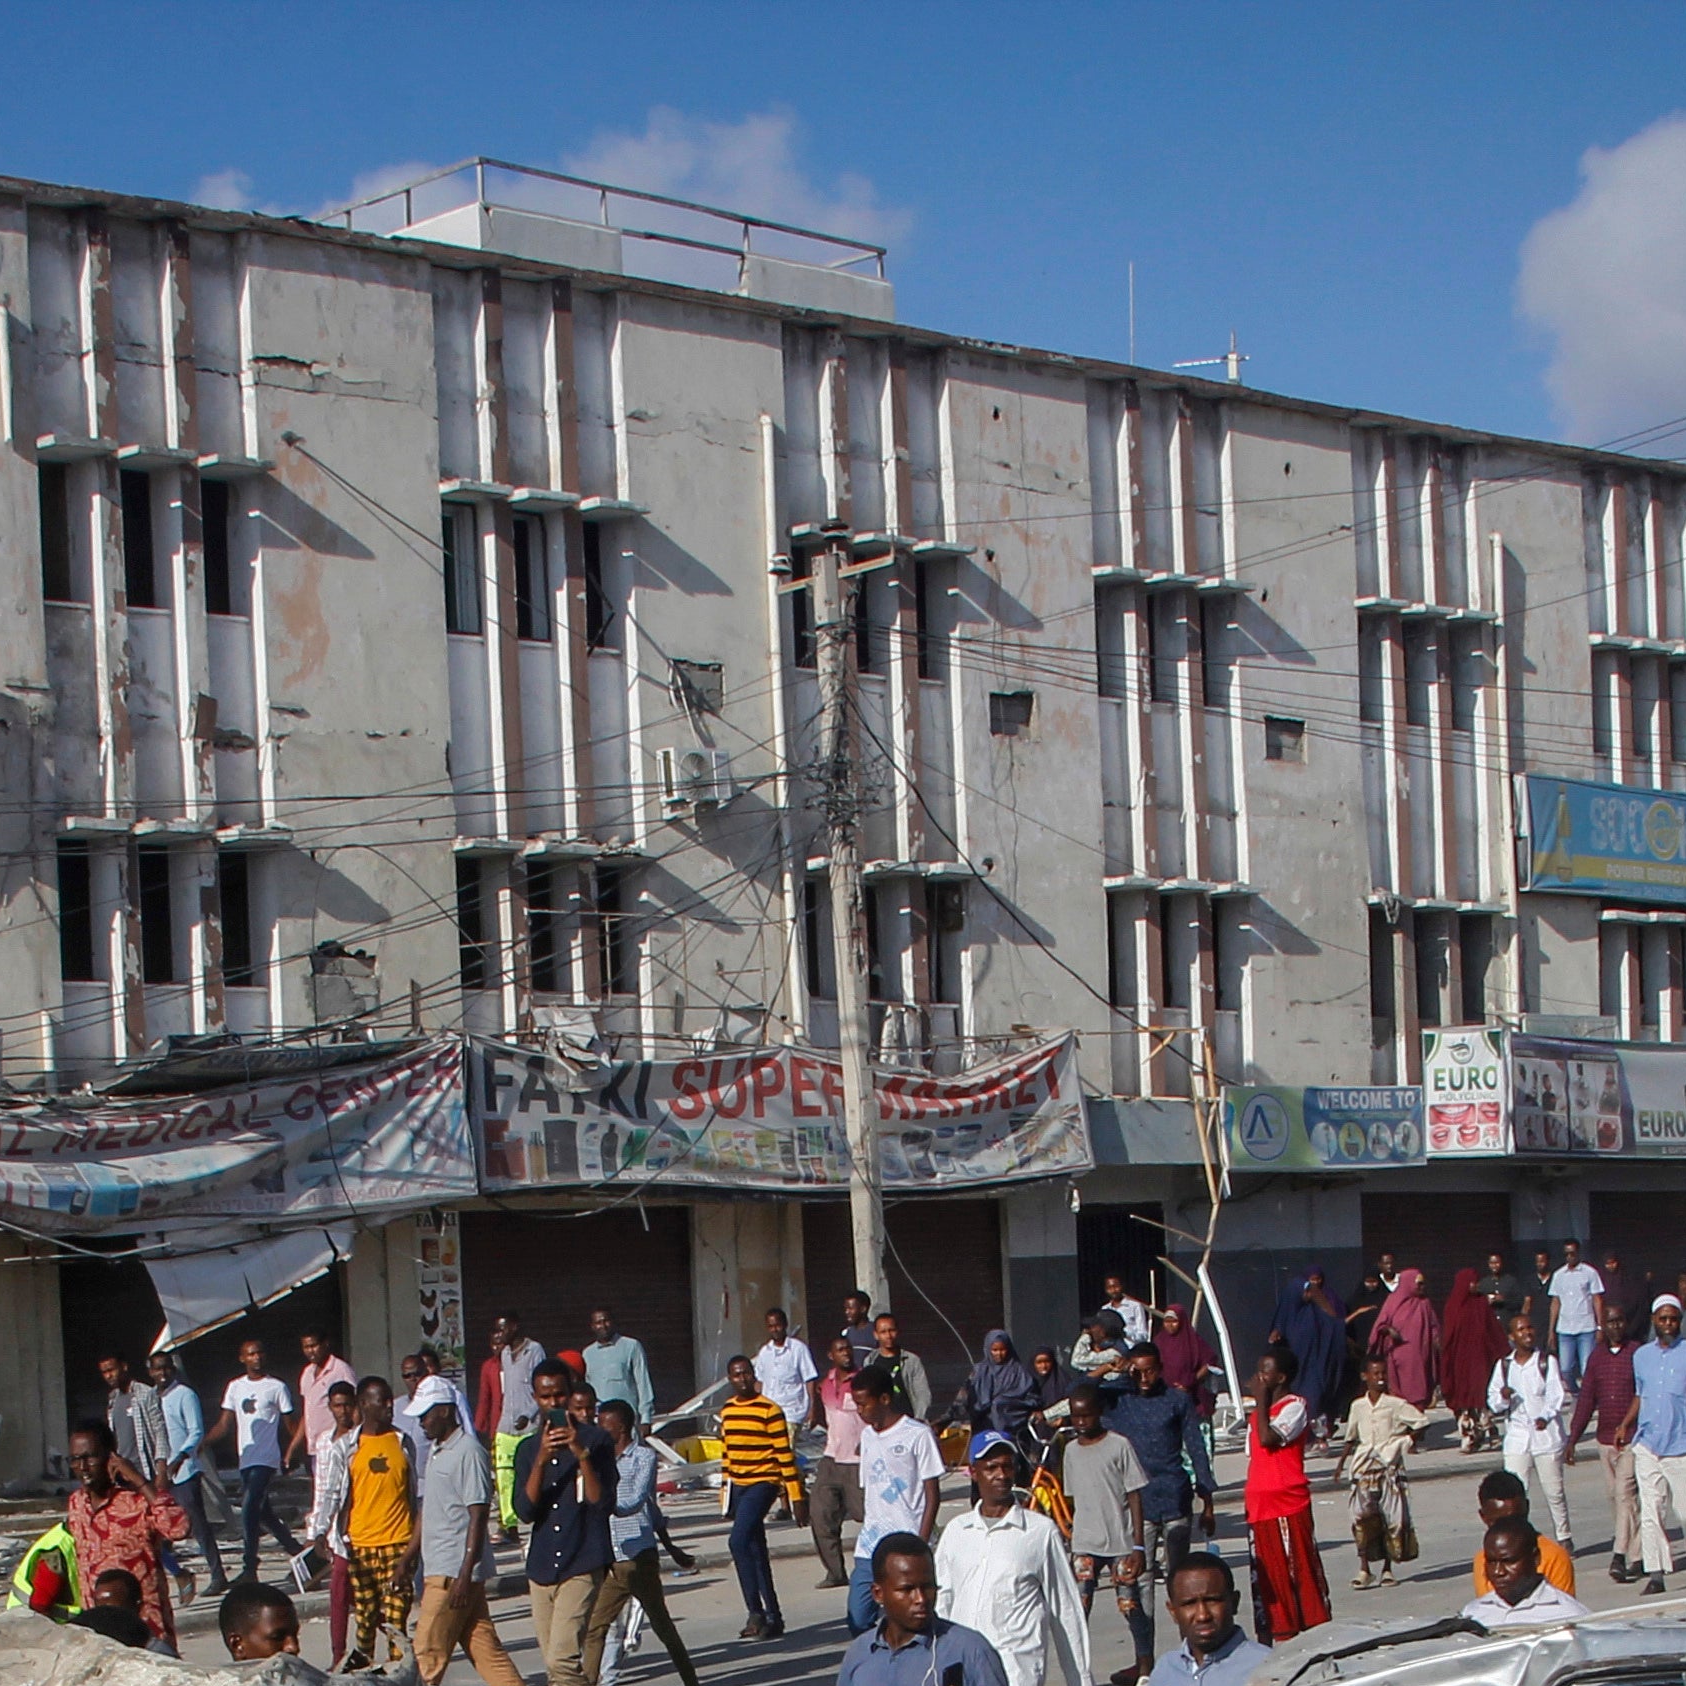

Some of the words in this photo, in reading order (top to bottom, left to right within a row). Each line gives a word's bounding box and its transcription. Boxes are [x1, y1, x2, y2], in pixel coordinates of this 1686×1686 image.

[1433, 1066, 1498, 1091] EURO
[52, 1094, 272, 1154] MEDICAL
[283, 1042, 462, 1121] CENTER
[1317, 1089, 1392, 1110] WELCOME
[1395, 1091, 1415, 1109] TO
[1438, 1092, 1499, 1102] POLYCLINIC
[1638, 1110, 1686, 1138] EURO
[416, 1213, 457, 1228] FAKI
